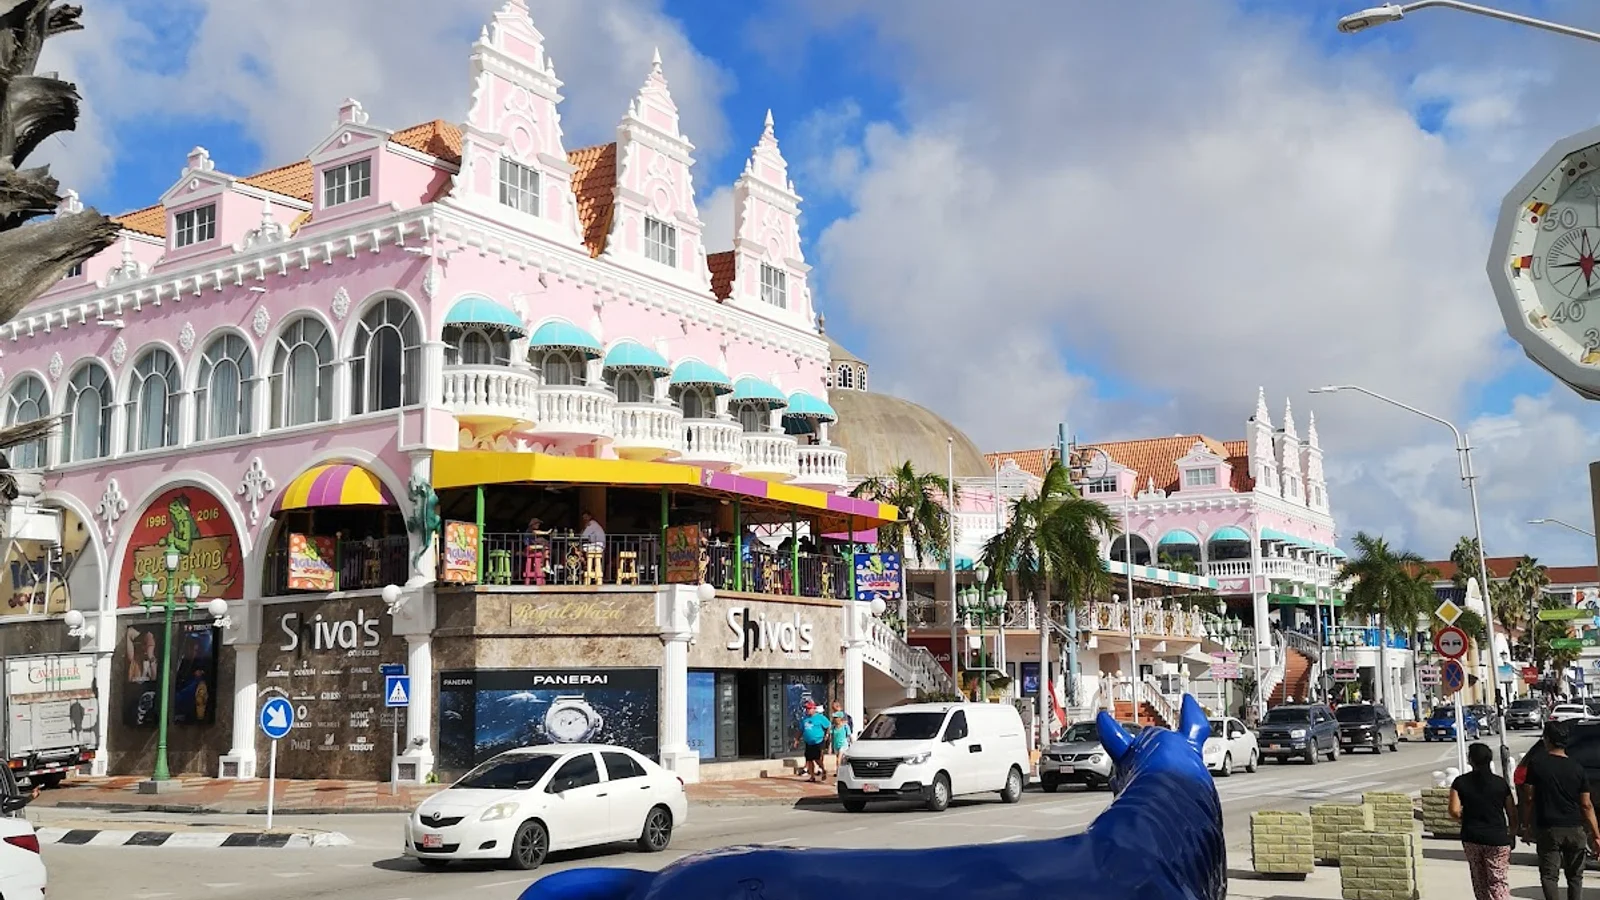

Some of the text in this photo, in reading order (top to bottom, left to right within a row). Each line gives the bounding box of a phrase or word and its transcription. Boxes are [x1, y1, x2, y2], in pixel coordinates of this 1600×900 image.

[1541, 207, 1578, 232] 50
[1551, 301, 1585, 324] 40
[145, 508, 219, 528] 1996 2016
[515, 601, 621, 626] Royal Plaza
[280, 608, 380, 656] Shiva's
[726, 607, 814, 661] Shiva's
[533, 675, 608, 685] PANERAI
